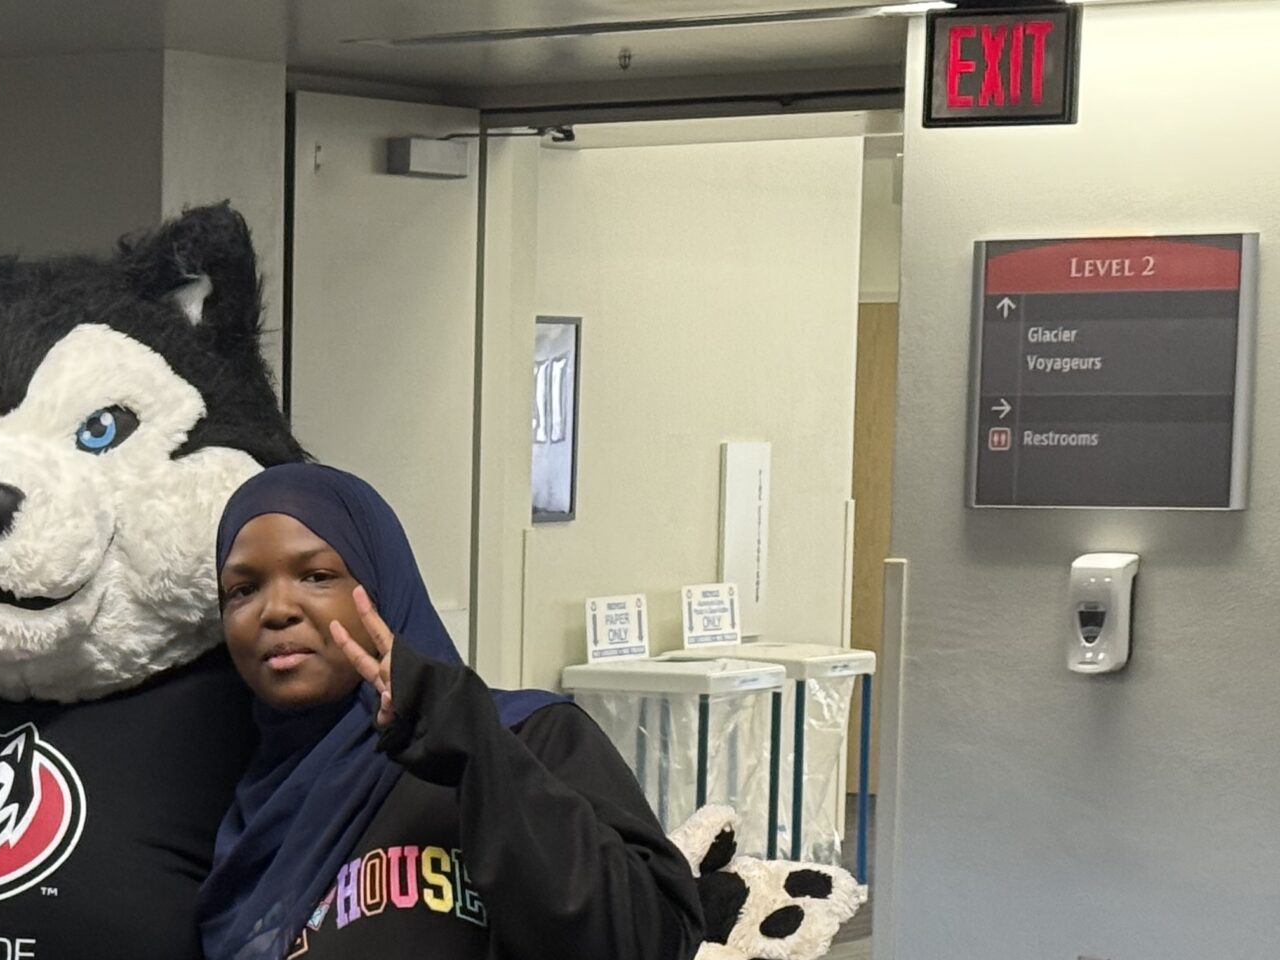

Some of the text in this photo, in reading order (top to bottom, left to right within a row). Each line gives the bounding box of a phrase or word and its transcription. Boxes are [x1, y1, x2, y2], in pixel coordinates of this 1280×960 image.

[947, 21, 1054, 108] EXIT
[1141, 255, 1155, 276] 2
[1028, 327, 1078, 342] Glacier
[1027, 355, 1102, 372] Voyageurs
[1024, 430, 1099, 446] Restrooms
[605, 612, 630, 625] PAPER
[703, 615, 722, 629] ONLY
[608, 628, 628, 641] ONLY
[40, 886, 58, 897] TM
